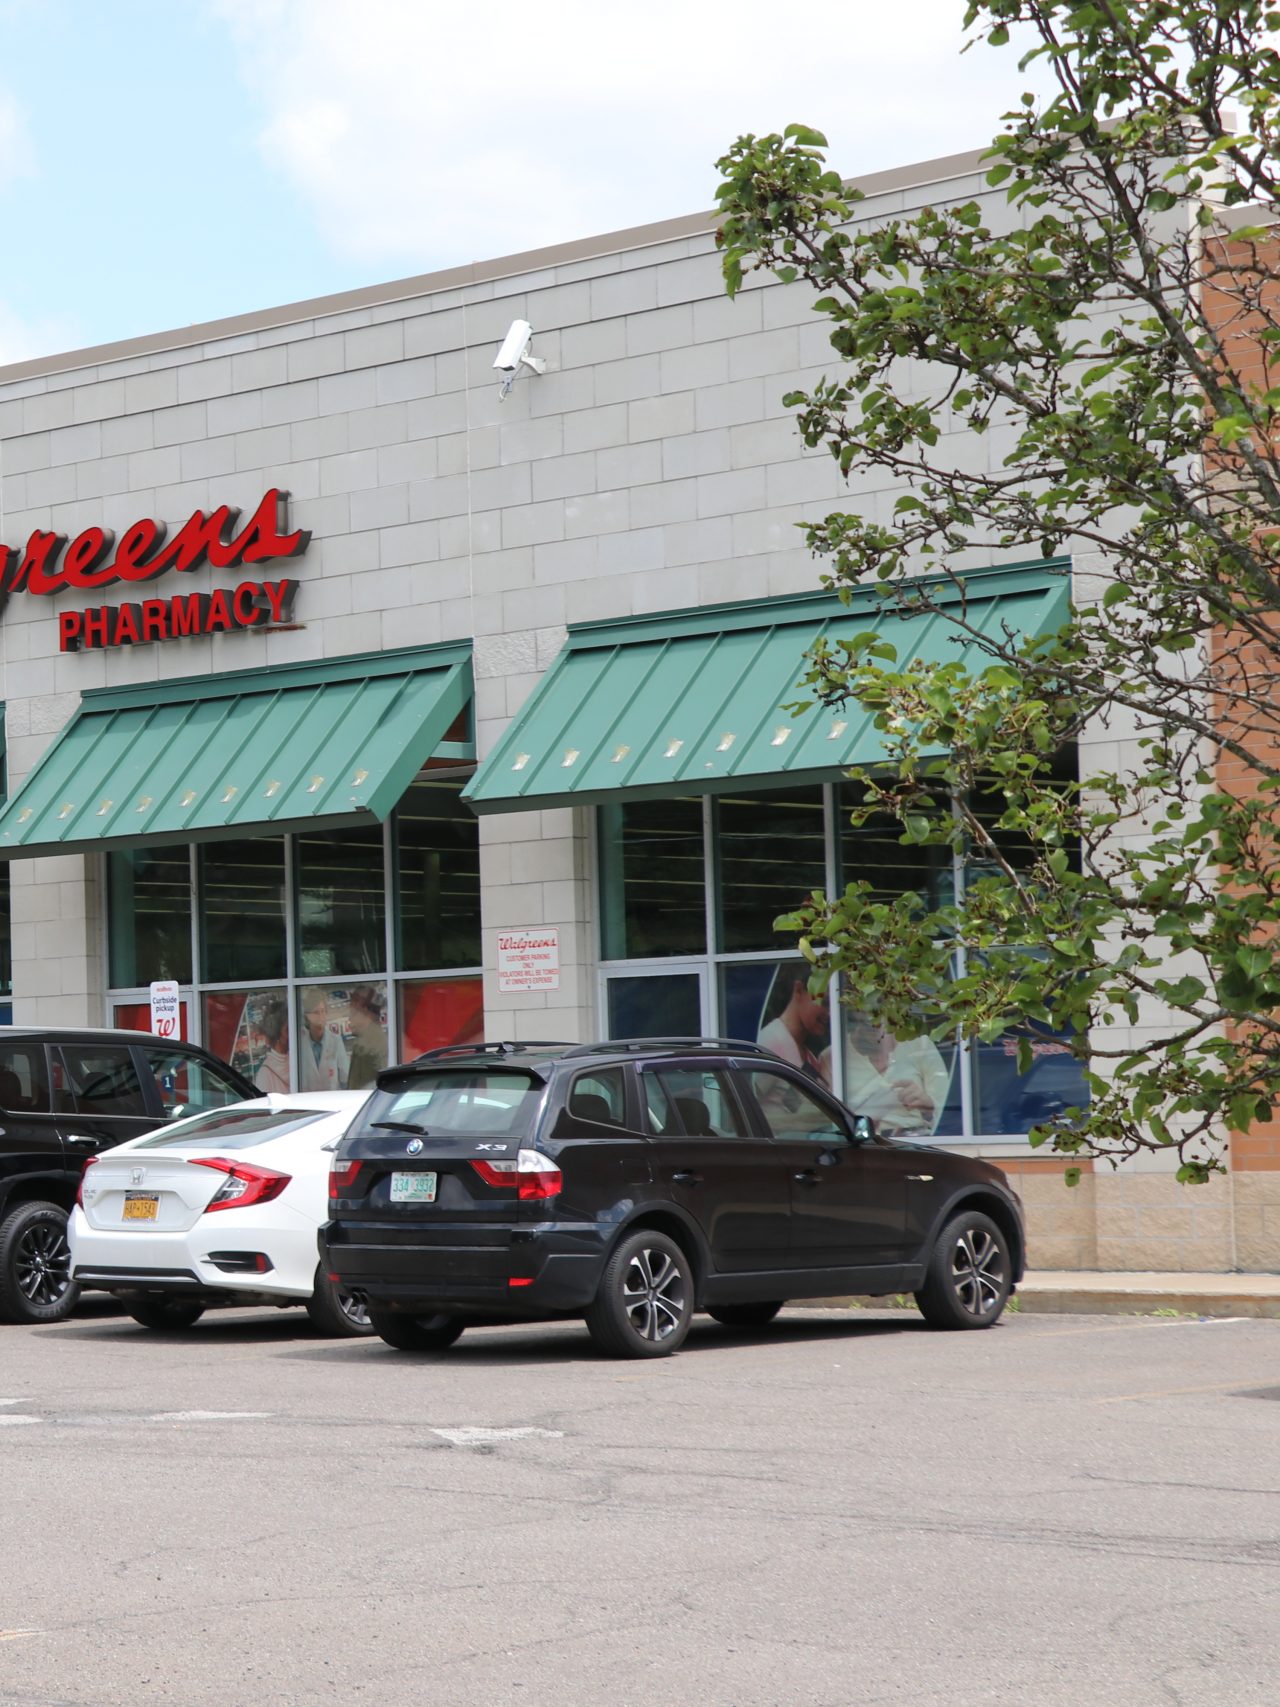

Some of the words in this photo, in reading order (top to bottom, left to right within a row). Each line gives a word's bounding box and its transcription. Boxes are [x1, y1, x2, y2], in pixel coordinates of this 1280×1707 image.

[60, 579, 299, 653] PHARMACY
[498, 937, 558, 953] Walgreens
[153, 996, 177, 1004] Curbside
[156, 1005, 175, 1013] pickup
[475, 1143, 508, 1151] X3
